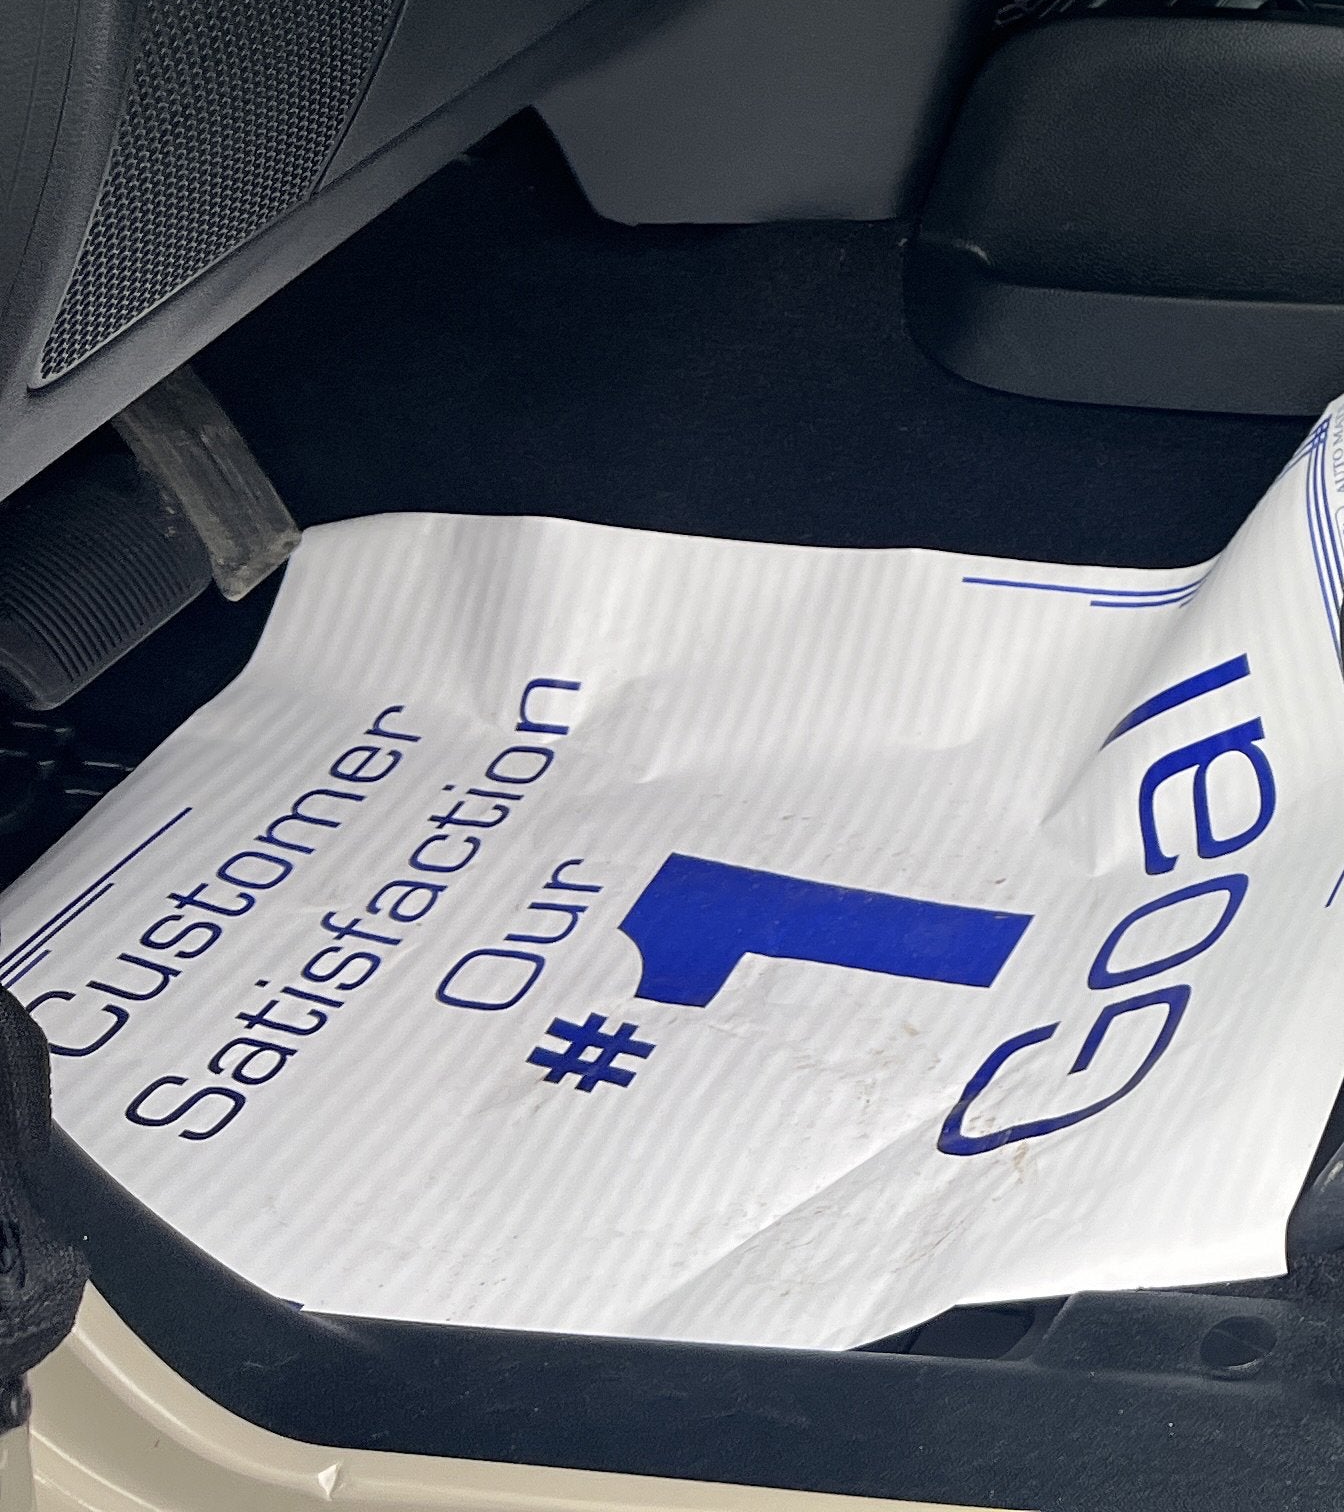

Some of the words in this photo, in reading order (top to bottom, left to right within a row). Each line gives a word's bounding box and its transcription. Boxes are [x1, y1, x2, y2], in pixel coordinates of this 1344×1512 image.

[25, 704, 422, 1058] Customer
[125, 677, 582, 1141] Satisfaction
[435, 858, 604, 1011] Our
[936, 653, 1277, 1157] Goal
